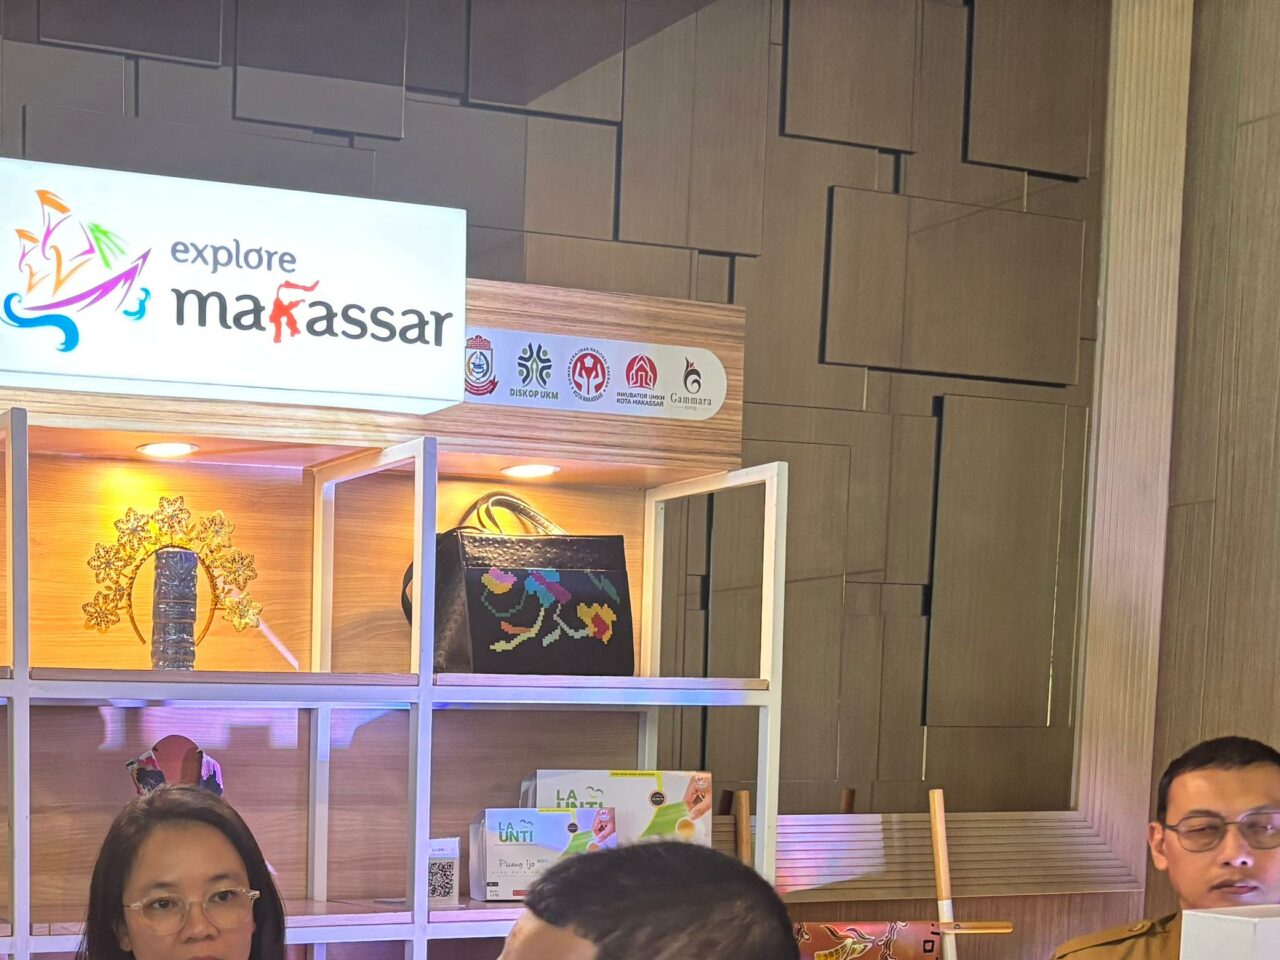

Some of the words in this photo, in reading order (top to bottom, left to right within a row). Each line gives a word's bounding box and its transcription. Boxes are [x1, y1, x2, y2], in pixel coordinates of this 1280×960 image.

[170, 237, 297, 274] explore
[509, 388, 539, 399] DISKOP
[540, 390, 558, 400] UKM
[616, 391, 648, 400] INKUBATOR
[648, 393, 666, 401] UMKM
[670, 392, 712, 406] Gammara
[632, 399, 664, 408] MAKASSAR
[556, 789, 577, 801] LA
[498, 821, 514, 831] LA
[499, 831, 533, 843] UNTI
